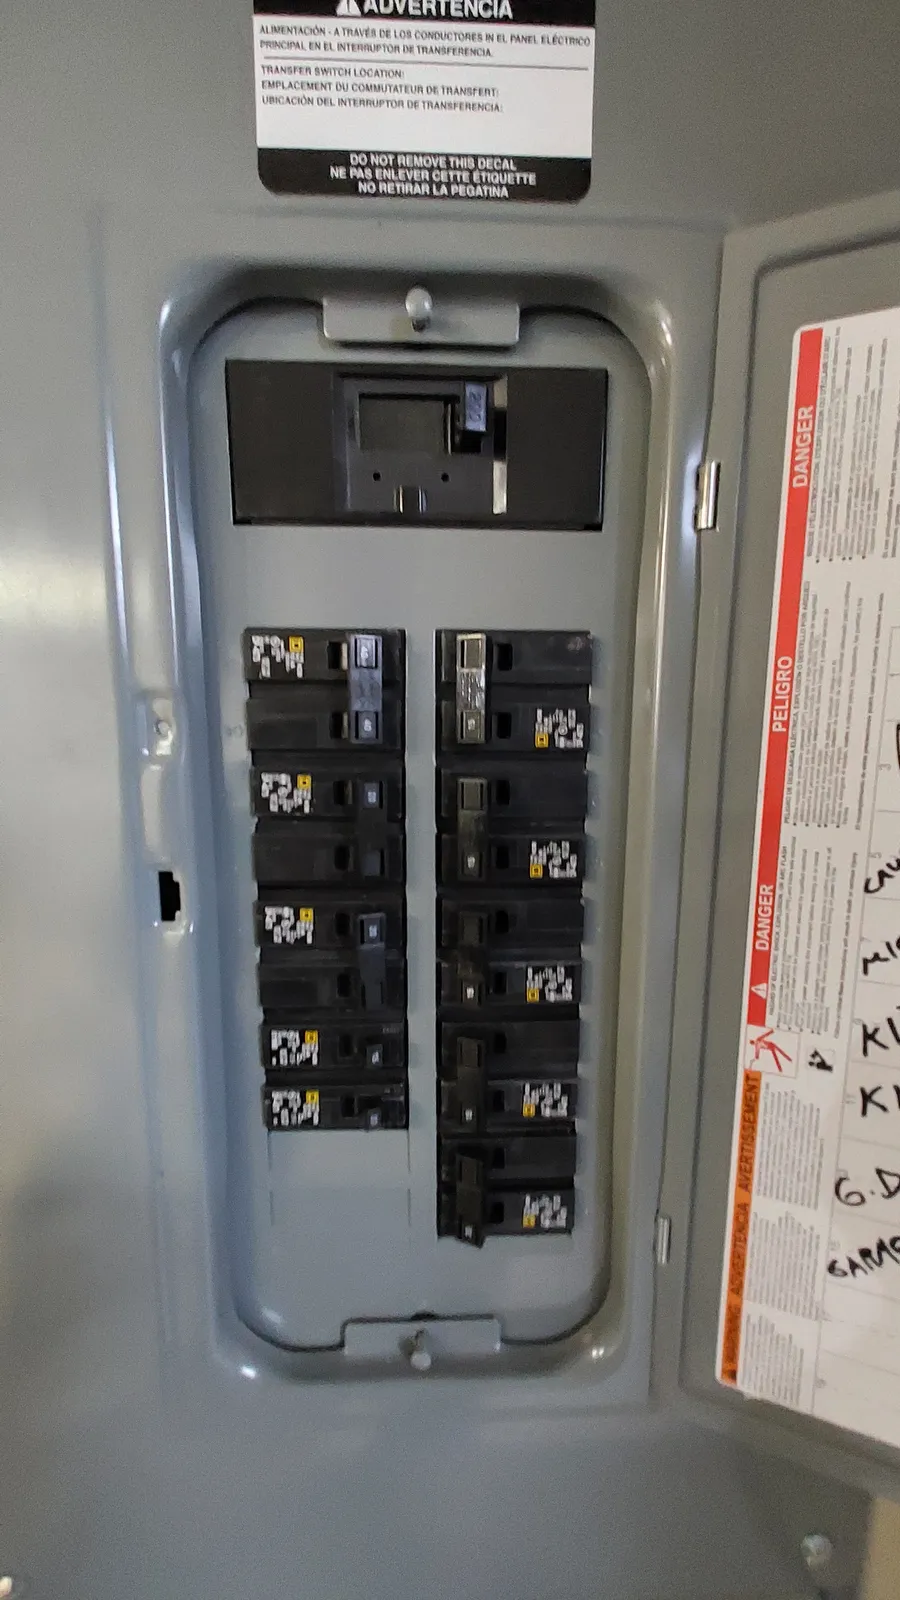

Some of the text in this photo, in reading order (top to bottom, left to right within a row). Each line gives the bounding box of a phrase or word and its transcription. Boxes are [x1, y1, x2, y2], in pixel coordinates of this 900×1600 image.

[363, 0, 513, 19] ADVERTENCIA
[259, 24, 326, 36] ALIMENTACIÓN
[334, 28, 342, 37] A
[342, 26, 376, 38] TRAVÉS
[379, 28, 392, 38] DE
[394, 28, 412, 38] LOS
[414, 30, 483, 42] CONDUCTORES
[485, 33, 494, 42] IN
[496, 34, 506, 44] EL
[510, 34, 538, 45] PANEL
[541, 33, 591, 46] ELÉCTRICO
[260, 40, 306, 51] PRINCIPAL
[309, 42, 321, 50] EN
[324, 42, 334, 51] EL
[336, 42, 400, 54] INTERRUPTOR
[403, 44, 415, 54] DE
[261, 65, 404, 79] TRANSFER SWITCH LOCATION:
[262, 80, 332, 92] EMPLACEMENT
[336, 82, 349, 92] DU
[352, 82, 423, 94] COMMUTATEUR
[426, 85, 439, 95] DE
[262, 94, 314, 106] UBICACIÓN
[316, 97, 335, 107] DEL
[338, 98, 405, 110] INTERRUPTOR
[407, 100, 419, 110] DE
[350, 152, 517, 171] DO NOT REMOVE THIS DECAL
[330, 166, 537, 186] NE PAS ENLEVER CETTE ÉTIQUETTE
[358, 181, 510, 198] NO RETIRAR LA PEGATINA
[792, 405, 814, 488] DANGER
[772, 655, 794, 733] PELIGRO
[754, 884, 774, 951] DANGER
[738, 1075, 760, 1192] AVERTISSEMENT
